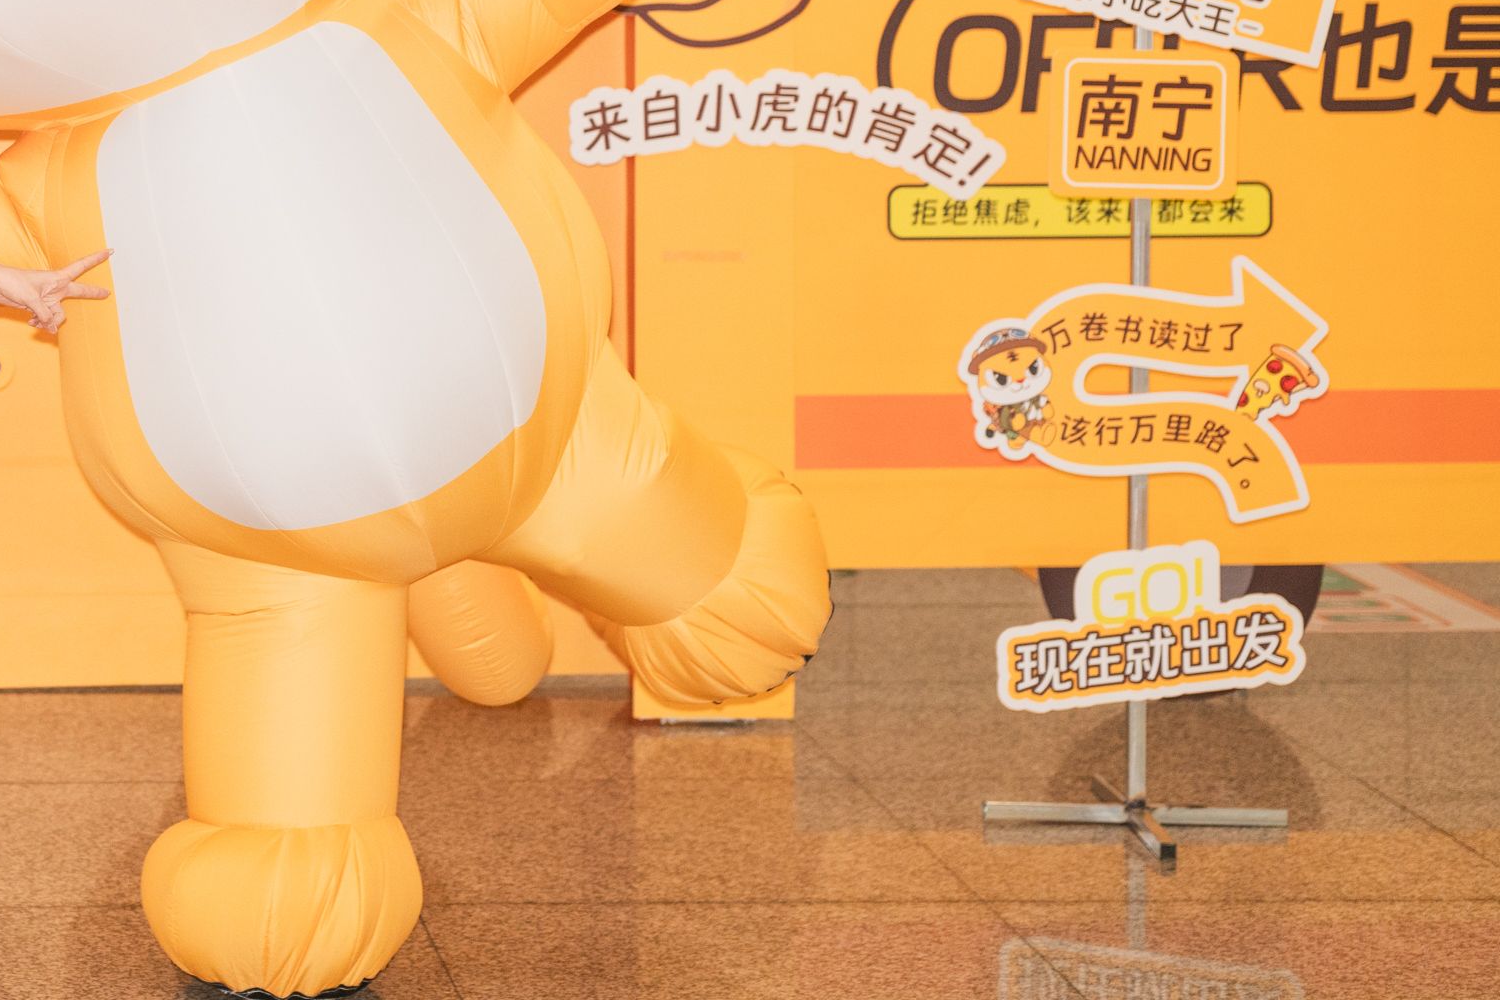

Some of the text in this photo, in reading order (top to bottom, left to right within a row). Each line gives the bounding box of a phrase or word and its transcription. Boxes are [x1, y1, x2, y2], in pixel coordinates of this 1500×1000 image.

[582, 83, 993, 188] 来自小虎的肯定!
[1076, 73, 1214, 142] 南宁
[1074, 144, 1213, 173] NANNING
[910, 197, 1246, 228] 拒绝焦虑，该来都会来
[1040, 310, 1246, 355] 万卷书读过了
[1091, 557, 1203, 626] GO!
[1014, 611, 1289, 695] 现在就出发
